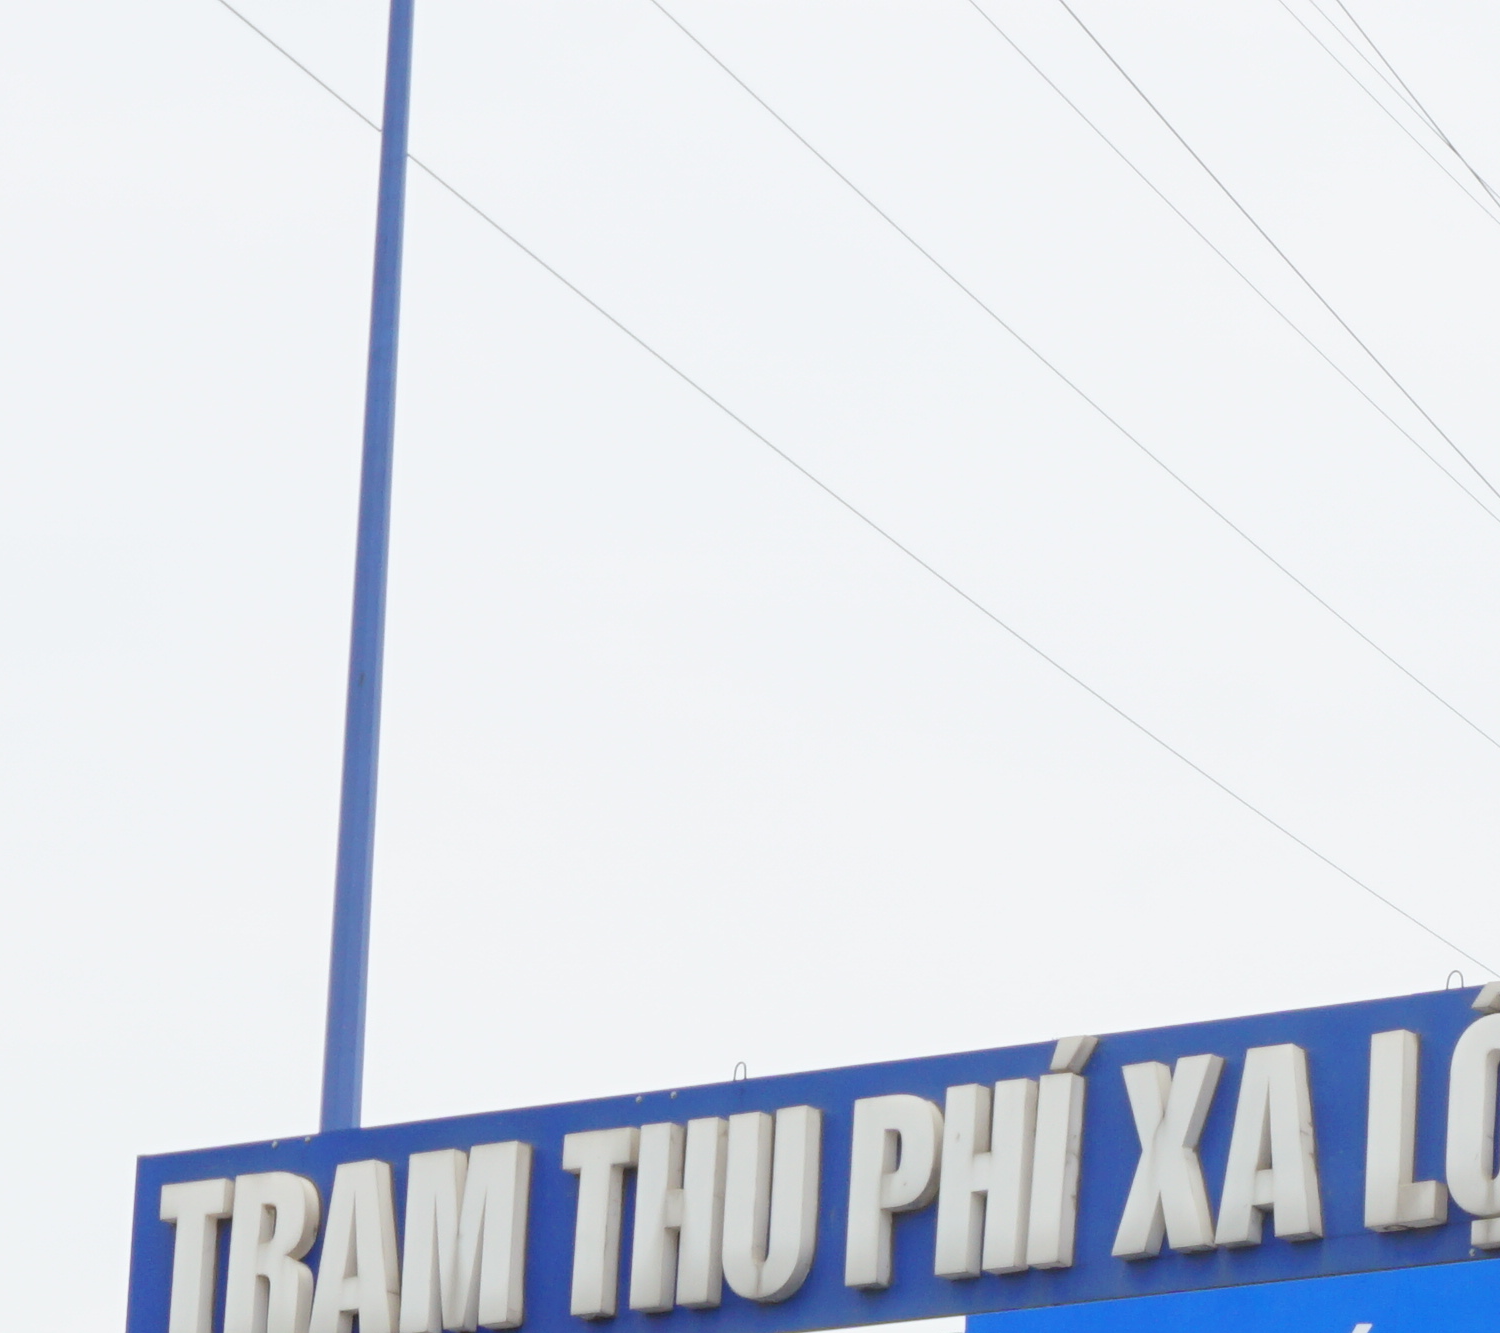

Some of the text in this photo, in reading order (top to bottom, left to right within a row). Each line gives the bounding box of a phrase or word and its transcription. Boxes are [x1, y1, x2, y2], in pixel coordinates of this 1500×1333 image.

[562, 1105, 824, 1320] THU
[844, 1034, 1098, 1289] PHÍ
[1111, 1043, 1323, 1261] XA
